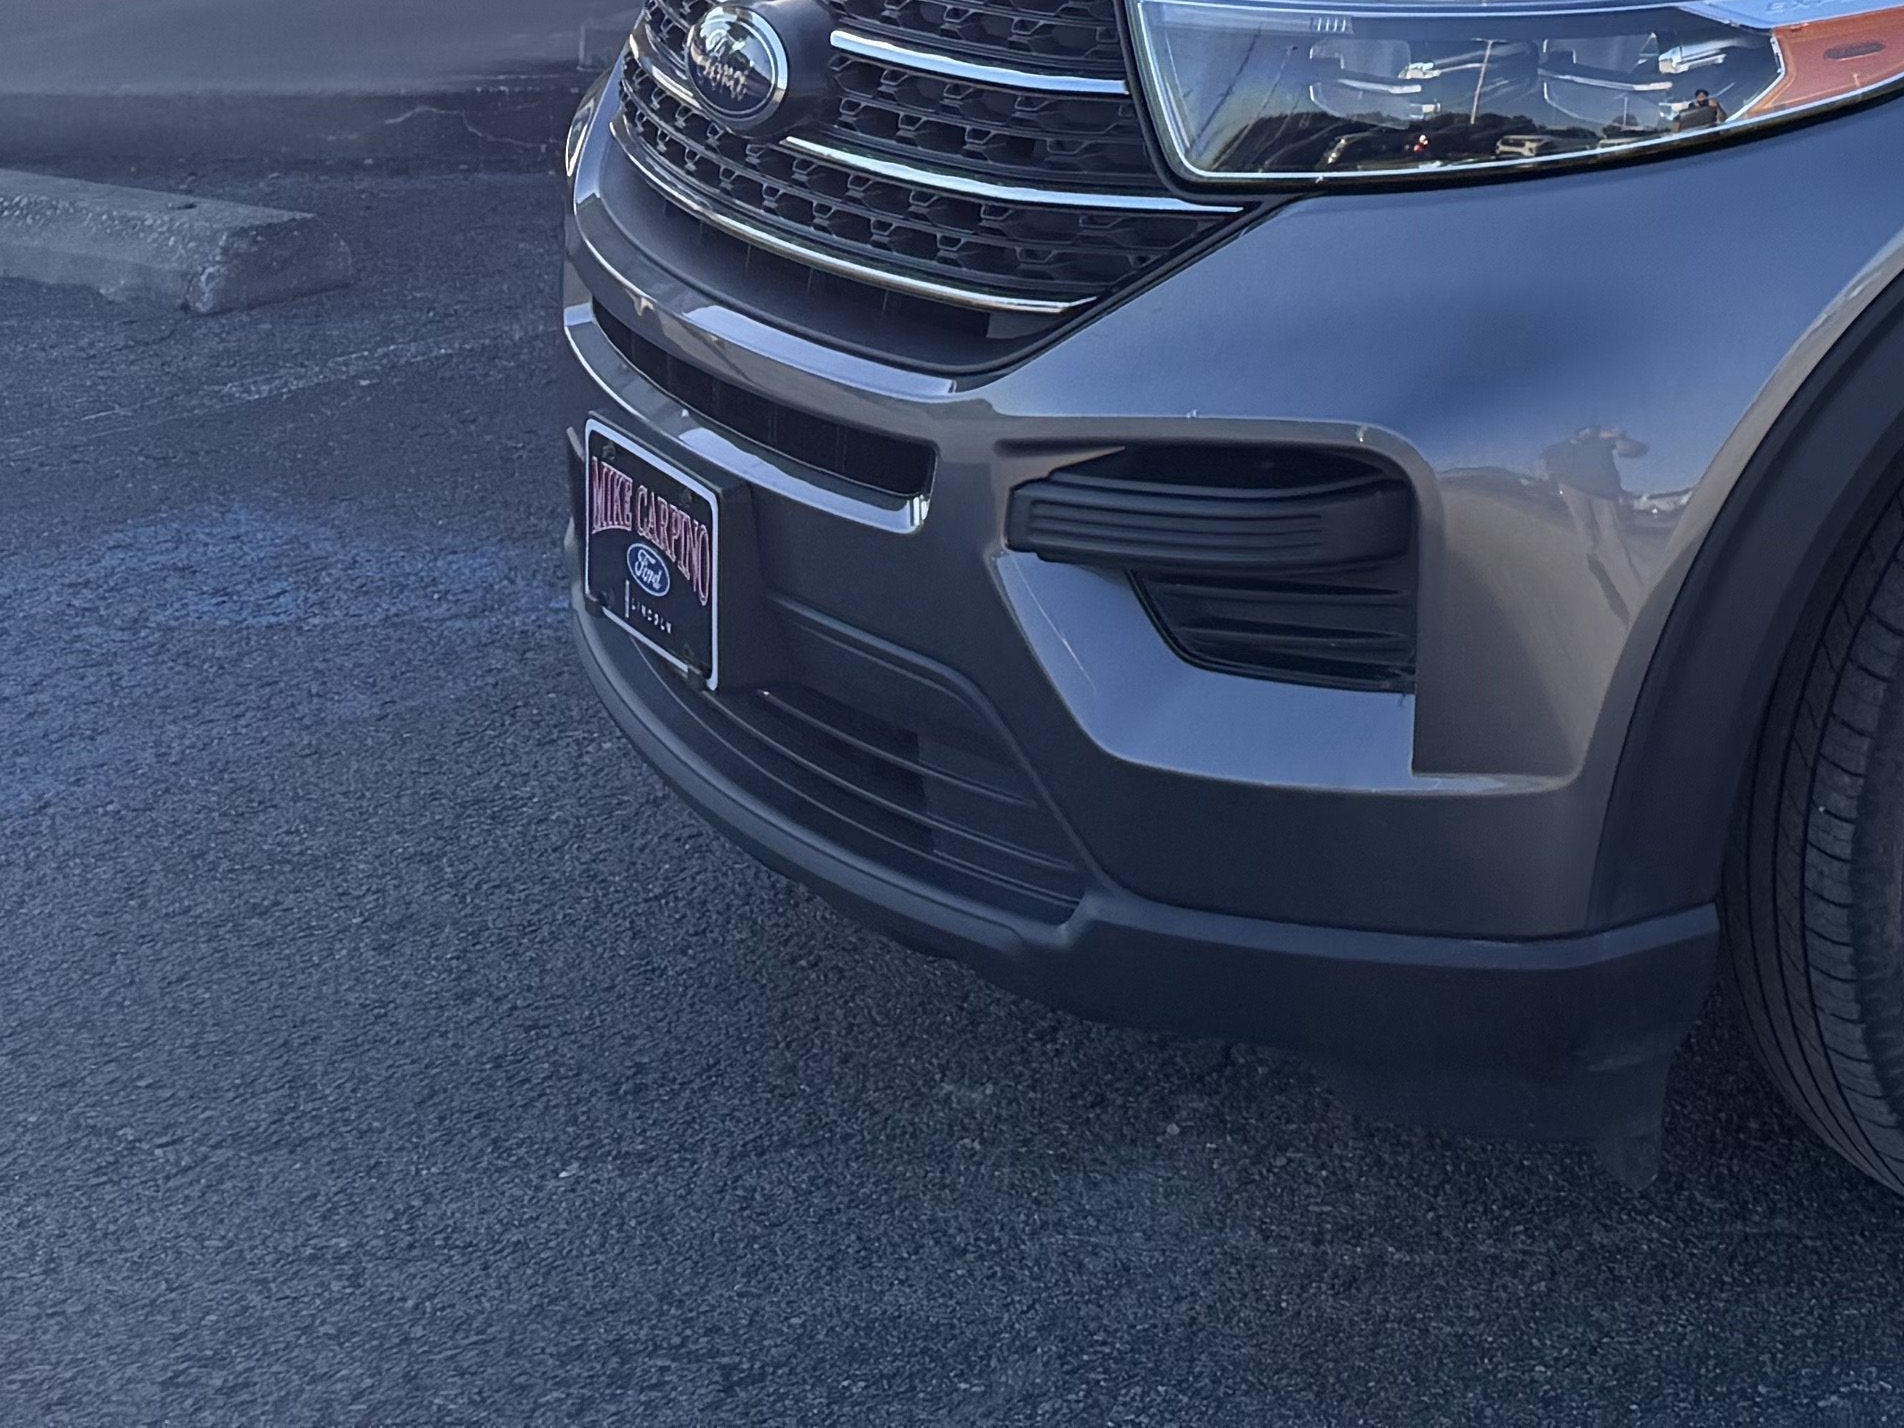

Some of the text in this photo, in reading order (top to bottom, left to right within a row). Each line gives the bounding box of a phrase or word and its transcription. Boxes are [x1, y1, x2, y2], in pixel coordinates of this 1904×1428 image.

[591, 455, 710, 607] MIKE CARPINO
[634, 548, 662, 590] Ford
